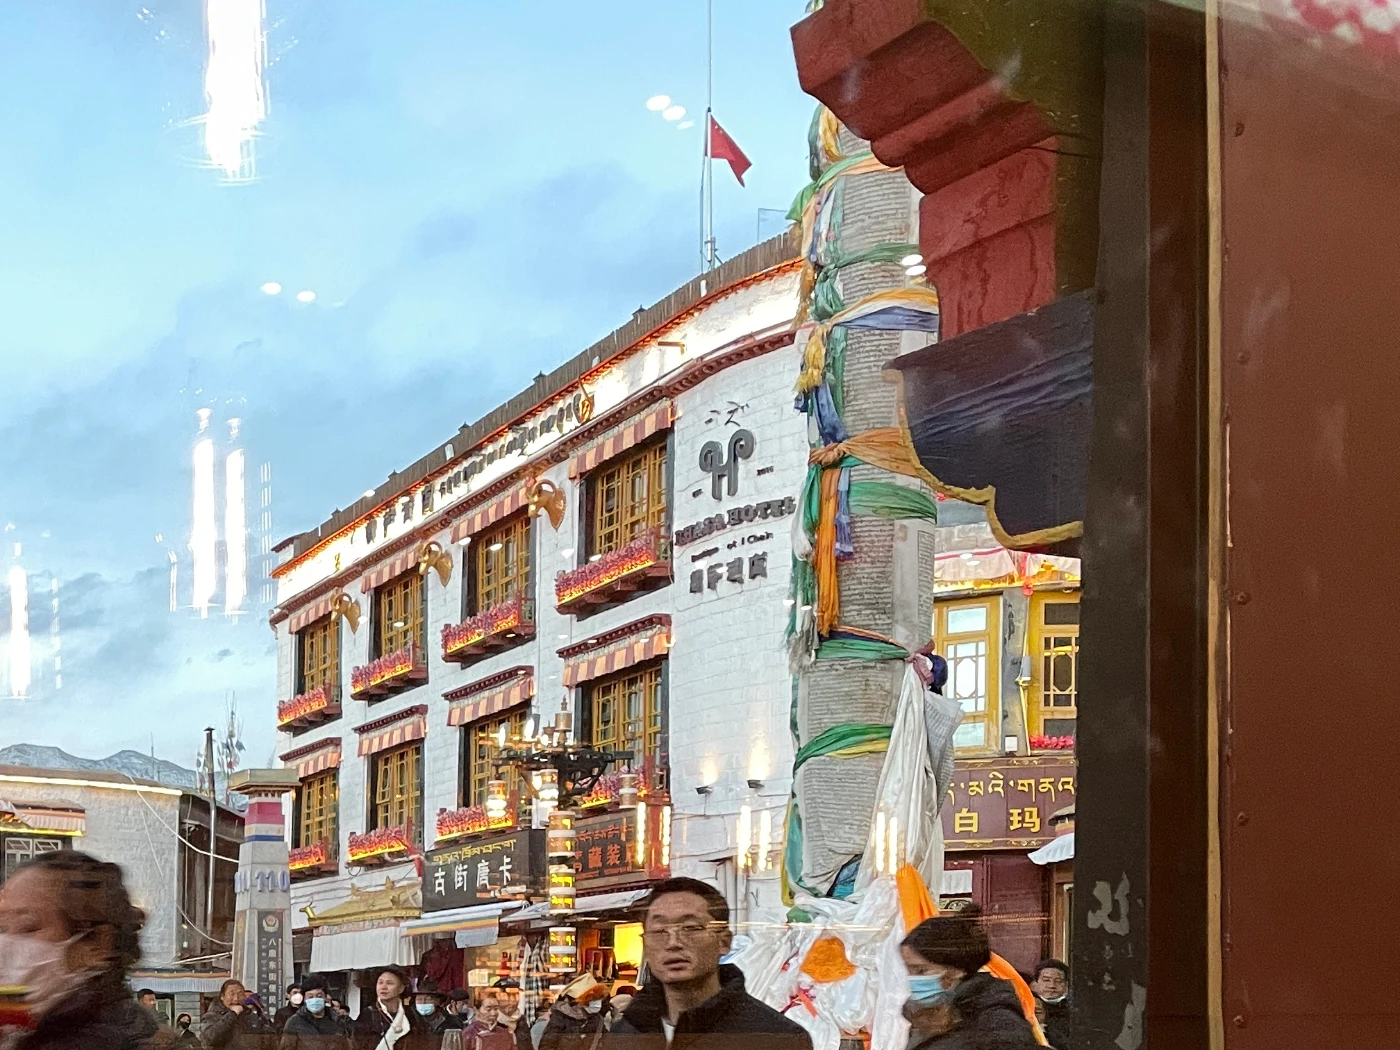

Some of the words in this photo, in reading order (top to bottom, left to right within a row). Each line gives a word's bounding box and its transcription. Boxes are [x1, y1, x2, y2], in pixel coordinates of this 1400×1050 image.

[954, 807, 1041, 833] 白玛
[255, 870, 290, 893] 110
[434, 854, 513, 896] 古街唐卡
